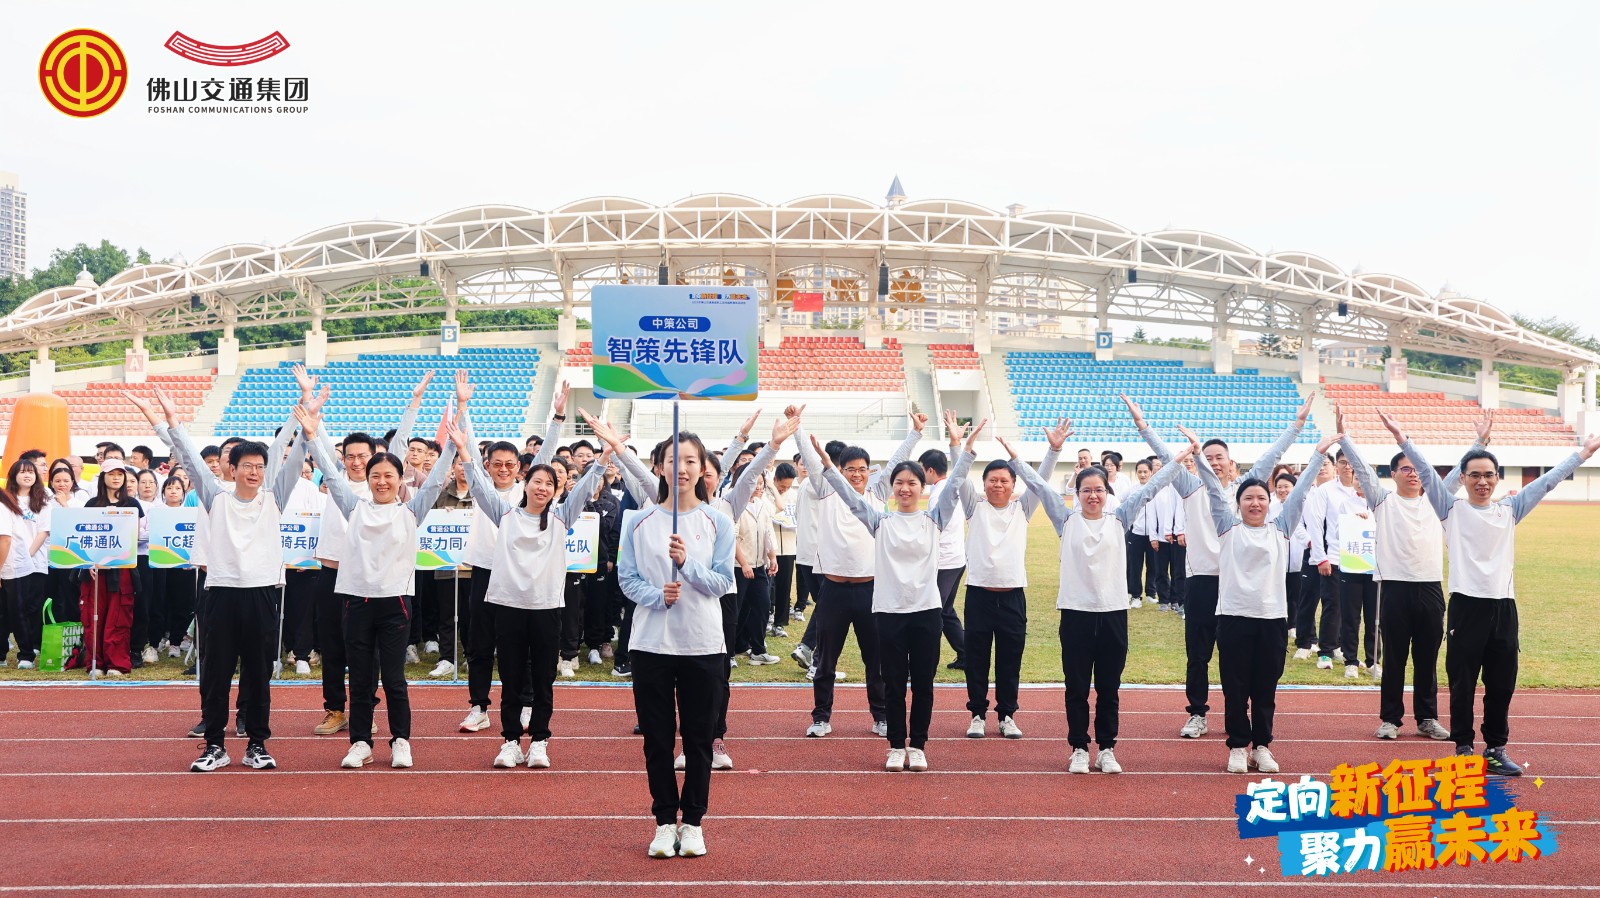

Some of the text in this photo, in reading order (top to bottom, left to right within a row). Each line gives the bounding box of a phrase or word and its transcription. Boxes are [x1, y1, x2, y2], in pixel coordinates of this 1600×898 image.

[652, 317, 699, 330] 中策公司
[444, 328, 454, 340] B
[1099, 334, 1109, 346] D
[607, 336, 744, 364] 智策先锋队
[129, 357, 140, 369] A
[79, 523, 110, 532] 广佛通公司
[64, 534, 122, 549] 广佛通队
[419, 536, 467, 551] 聚力同
